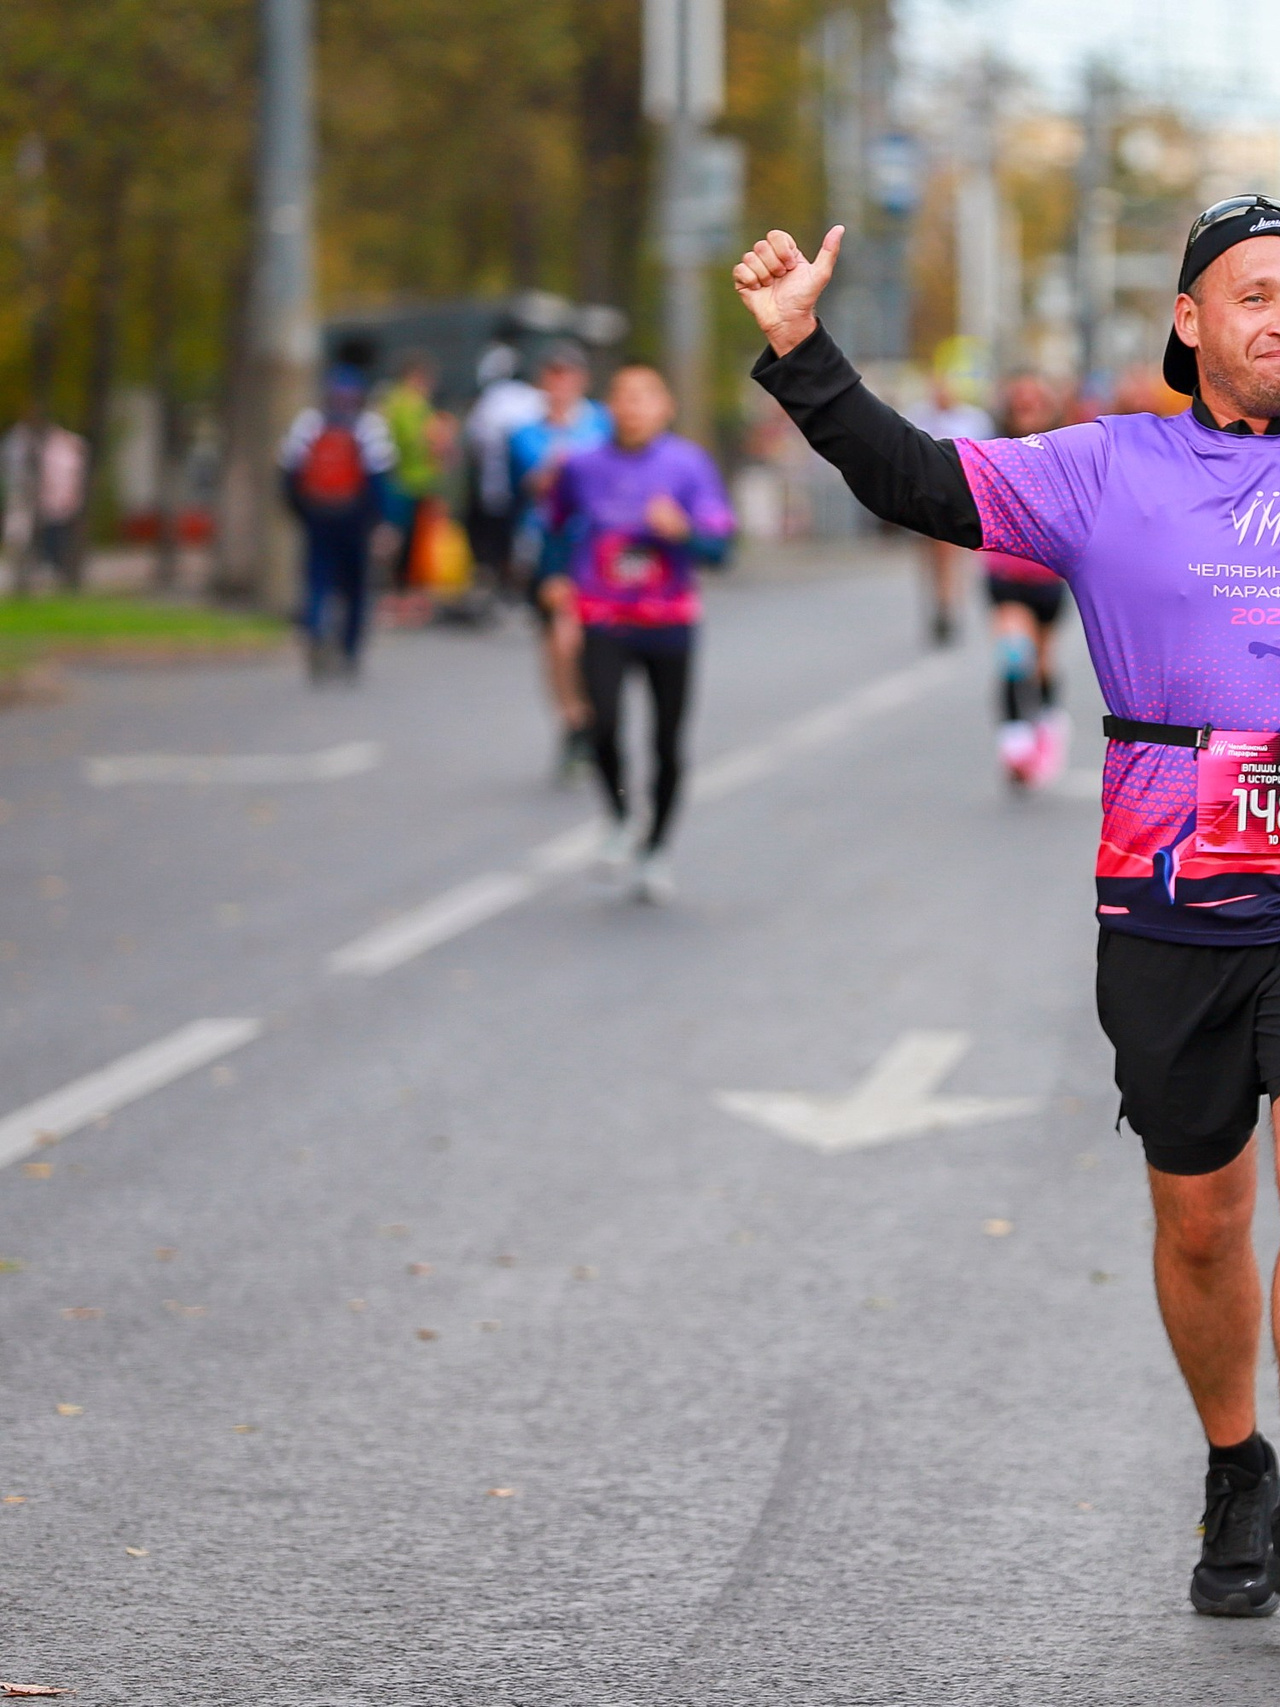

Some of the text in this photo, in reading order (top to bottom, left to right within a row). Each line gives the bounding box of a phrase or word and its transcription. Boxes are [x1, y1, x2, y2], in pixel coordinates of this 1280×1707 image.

[1241, 763, 1276, 773] ВПИШИ
[1238, 774, 1245, 783] В
[1268, 835, 1279, 845] 10
